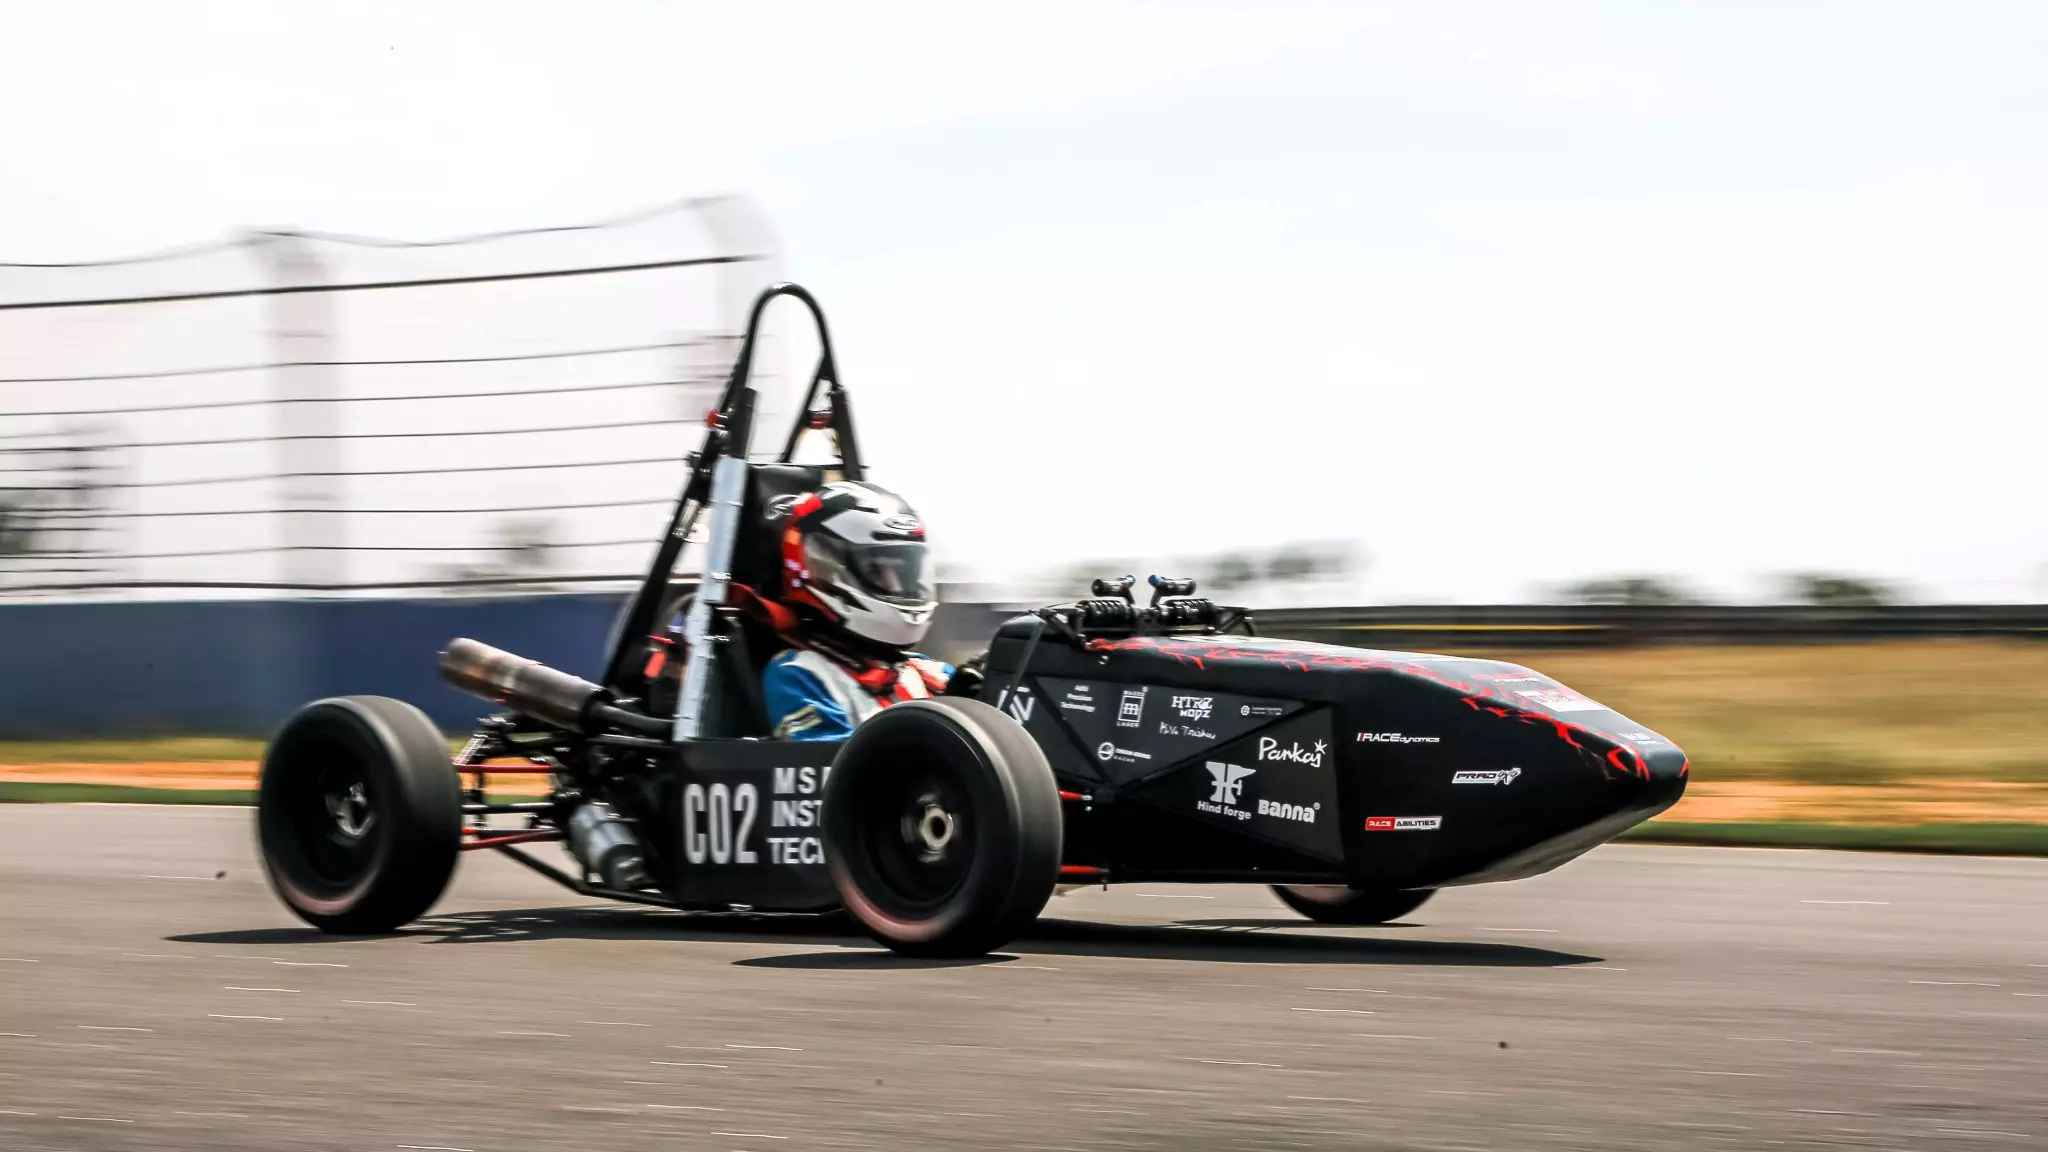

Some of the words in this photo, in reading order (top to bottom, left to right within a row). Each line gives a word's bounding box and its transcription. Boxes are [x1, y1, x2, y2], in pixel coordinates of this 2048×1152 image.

[1197, 801, 1222, 814] Hind
[1223, 805, 1252, 820] forge
[1396, 819, 1437, 827] ABILITIES
